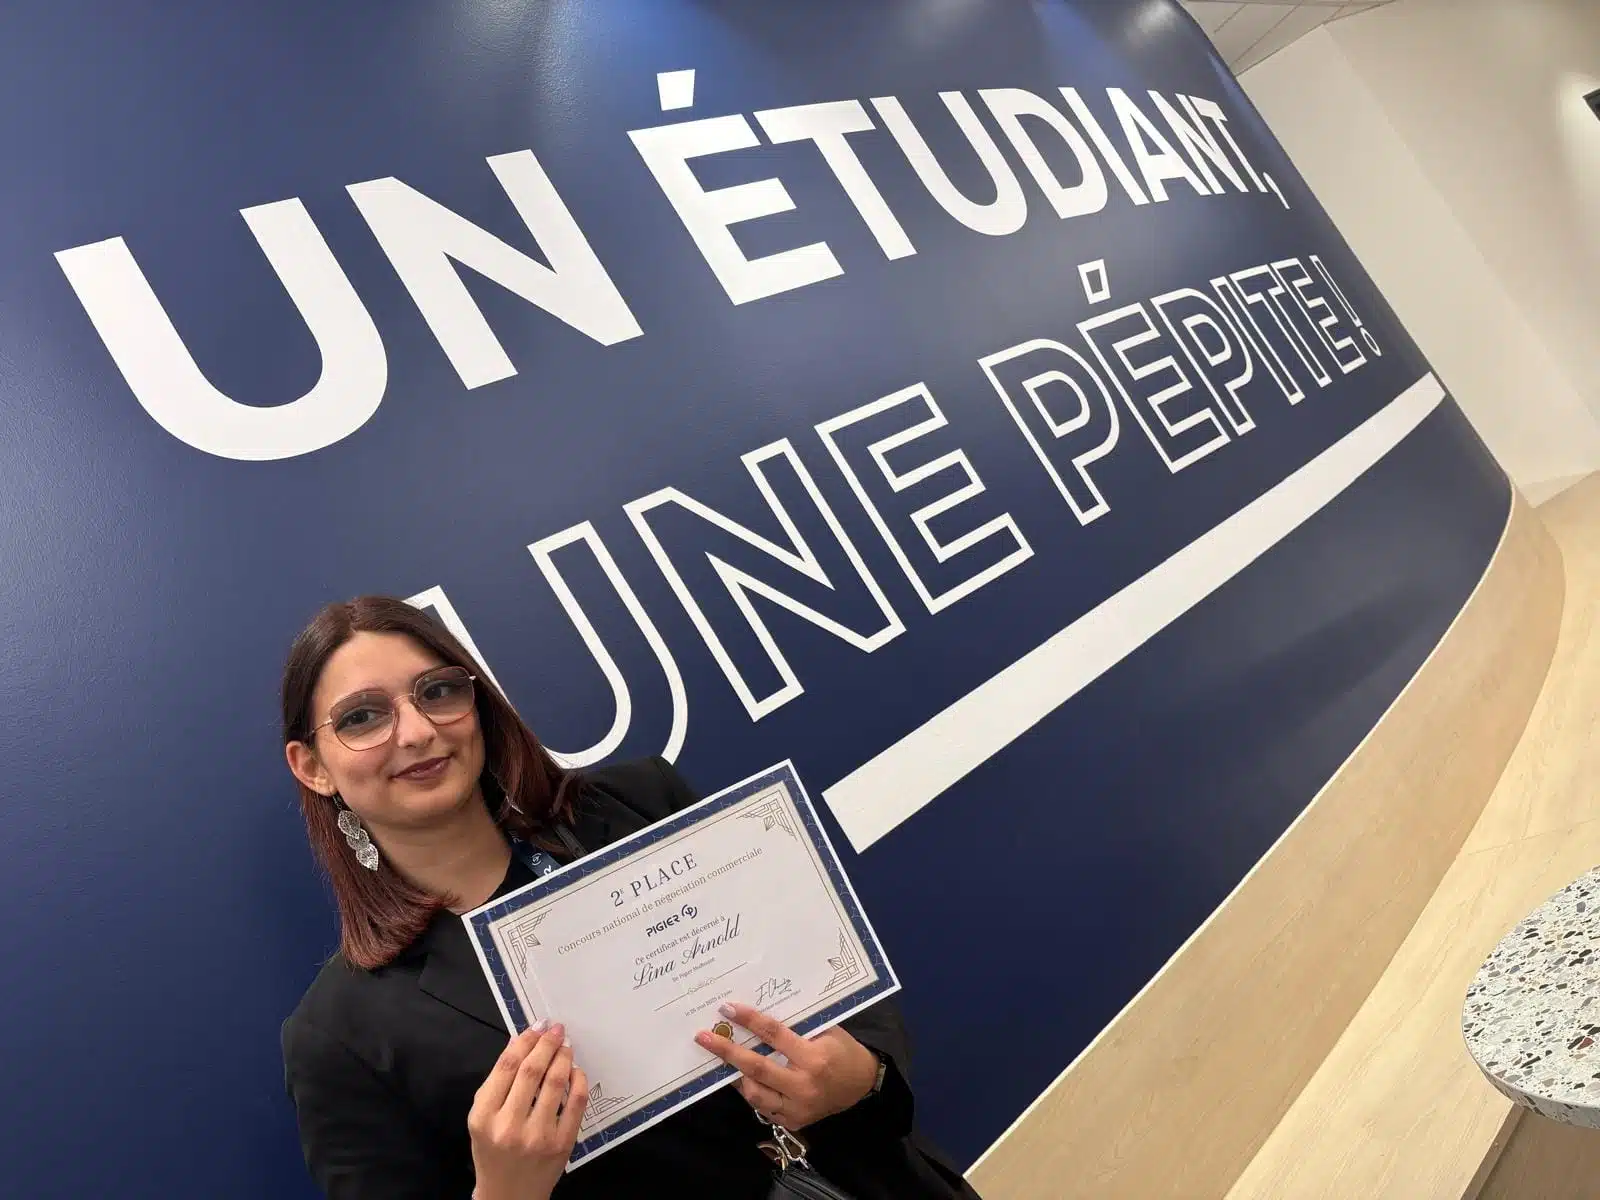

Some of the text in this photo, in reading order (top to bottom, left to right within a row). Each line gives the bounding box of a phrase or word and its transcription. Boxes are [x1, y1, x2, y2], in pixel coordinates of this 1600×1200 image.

[53, 69, 1289, 462] UN ÉTUDIANT,
[401, 381, 1035, 769] UNE
[557, 847, 763, 955] Concours national de négociation commerciale
[630, 853, 697, 898] PLACE
[632, 913, 741, 990] Lina Arnold
[635, 914, 727, 966] Ce certificat est décerné à
[646, 914, 681, 938] PIGIER
